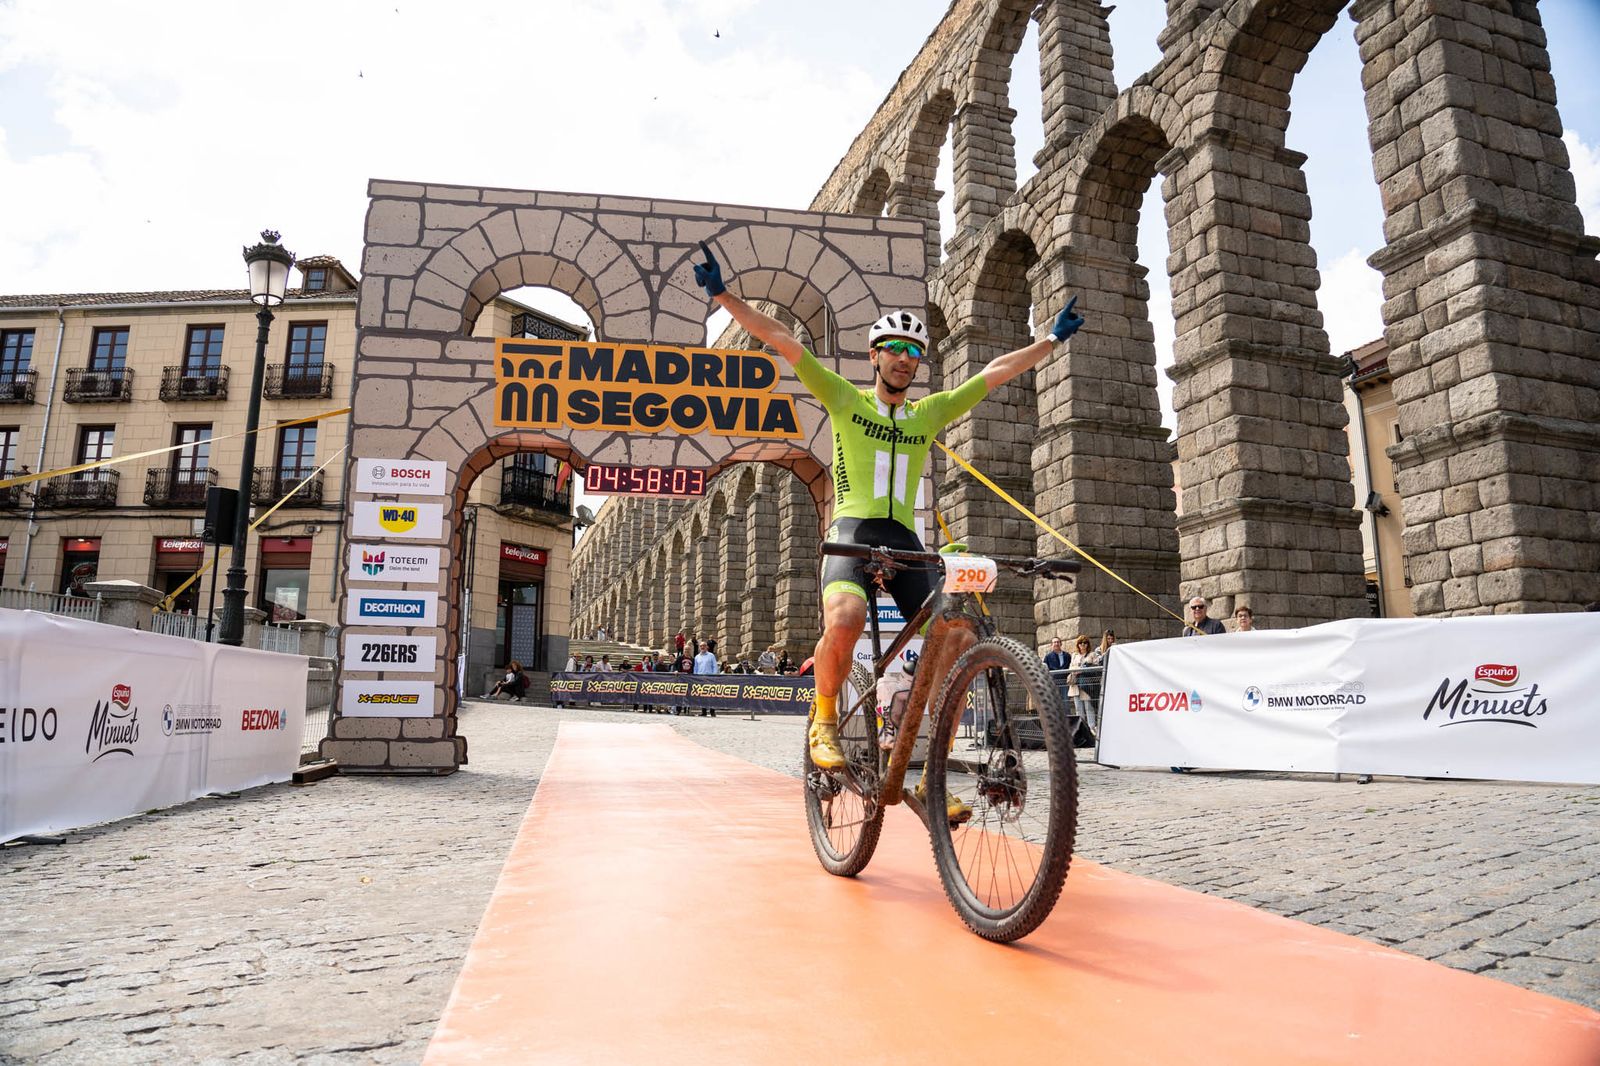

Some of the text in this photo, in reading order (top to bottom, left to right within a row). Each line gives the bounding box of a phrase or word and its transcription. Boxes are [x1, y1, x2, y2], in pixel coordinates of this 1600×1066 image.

[567, 346, 776, 390] MADRID
[566, 389, 799, 434] SEGOVIA
[391, 468, 431, 479] BOSCH
[587, 465, 704, 494] 04:58:03
[383, 509, 415, 522] WD-40
[390, 556, 428, 565] TOTEEMI
[504, 547, 539, 561] telepizza
[956, 568, 987, 583] 290
[364, 602, 420, 614] DECATHLON
[361, 643, 417, 663] 226ERS
[1477, 666, 1514, 677] Espuña
[550, 680, 583, 692] AUCE
[358, 693, 420, 704] X-SAUCE
[1128, 692, 1189, 712] BEZOYA
[1267, 694, 1367, 707] BMW MOTORRAD
[1423, 677, 1548, 720] Minuets
[86, 699, 139, 754] Minuets
[175, 718, 190, 730] BMW
[241, 708, 279, 731] BEZOYA
